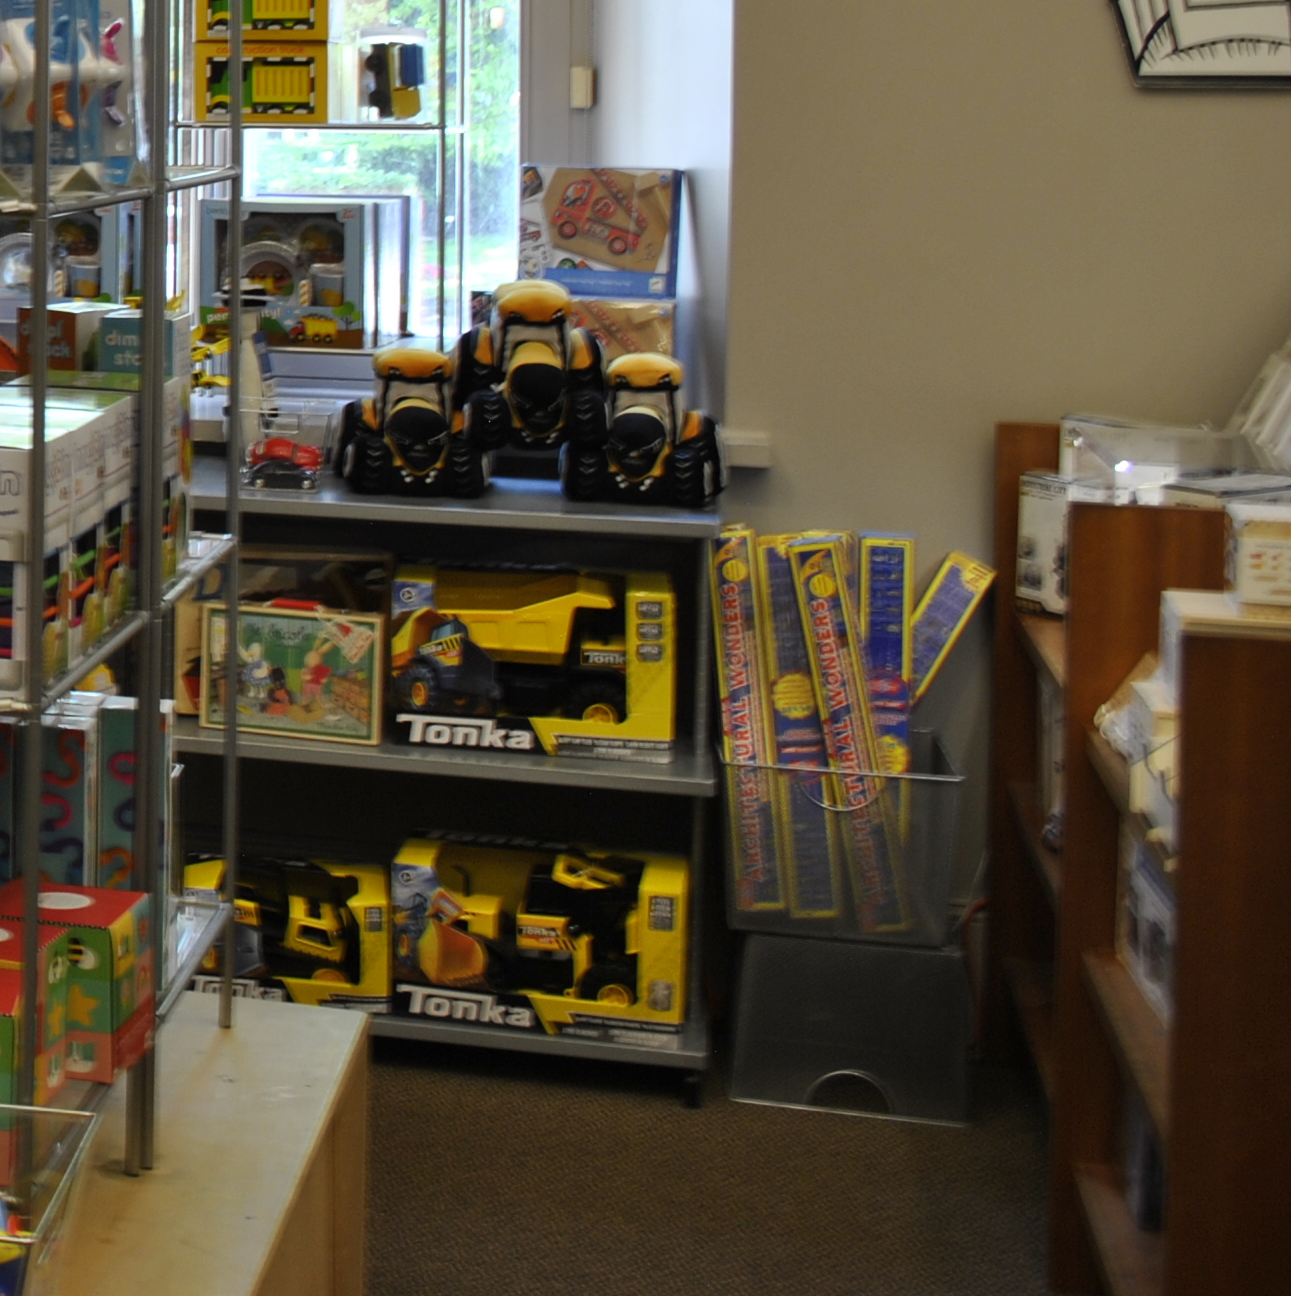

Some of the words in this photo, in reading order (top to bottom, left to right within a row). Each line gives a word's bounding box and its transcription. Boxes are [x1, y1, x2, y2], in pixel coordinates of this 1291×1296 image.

[216, 45, 277, 54] coruction
[280, 45, 305, 54] truck
[722, 583, 749, 691] WONDERS
[810, 598, 847, 710] WONDERS
[583, 651, 626, 665] Tonk
[396, 713, 535, 750] Tonka
[521, 925, 557, 937] Tonka
[396, 984, 535, 1027] Tonka
